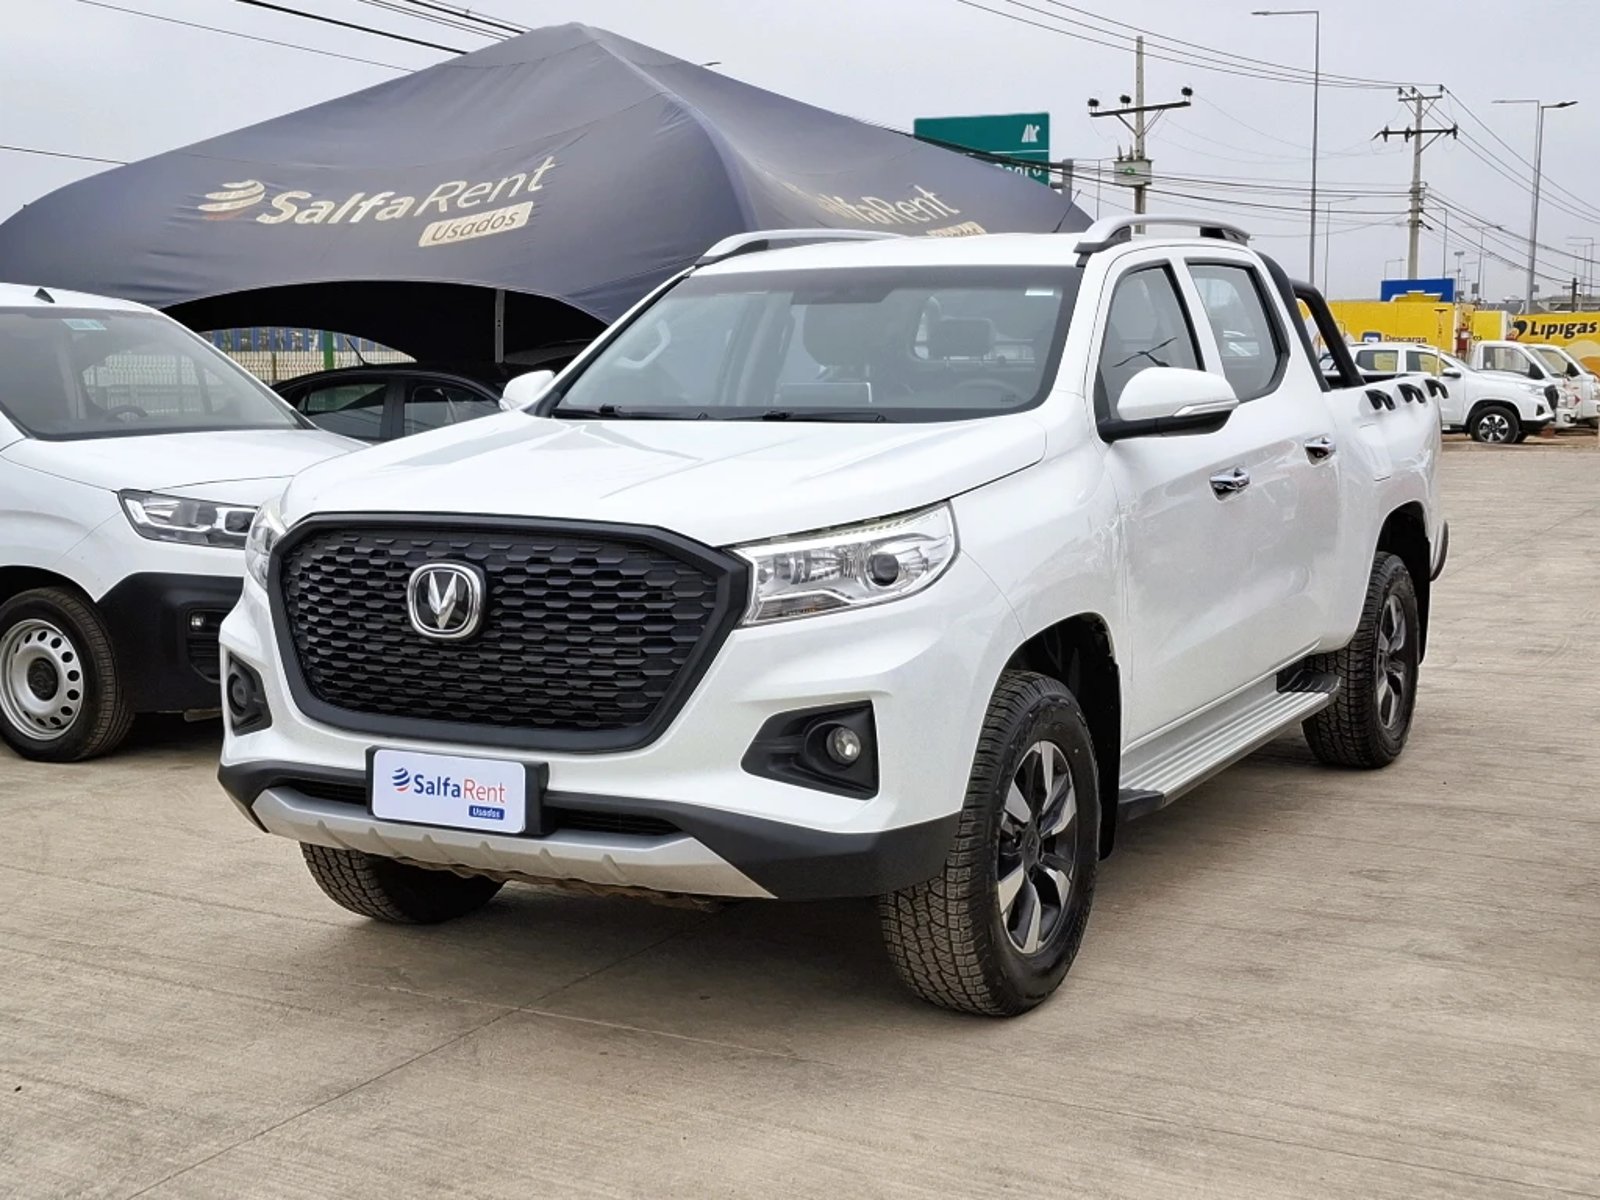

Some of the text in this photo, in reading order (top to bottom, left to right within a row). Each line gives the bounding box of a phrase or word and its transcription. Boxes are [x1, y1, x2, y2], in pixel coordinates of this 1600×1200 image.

[431, 209, 519, 242] Usados
[1530, 321, 1598, 340] Lipigas
[472, 807, 501, 819] Usados
